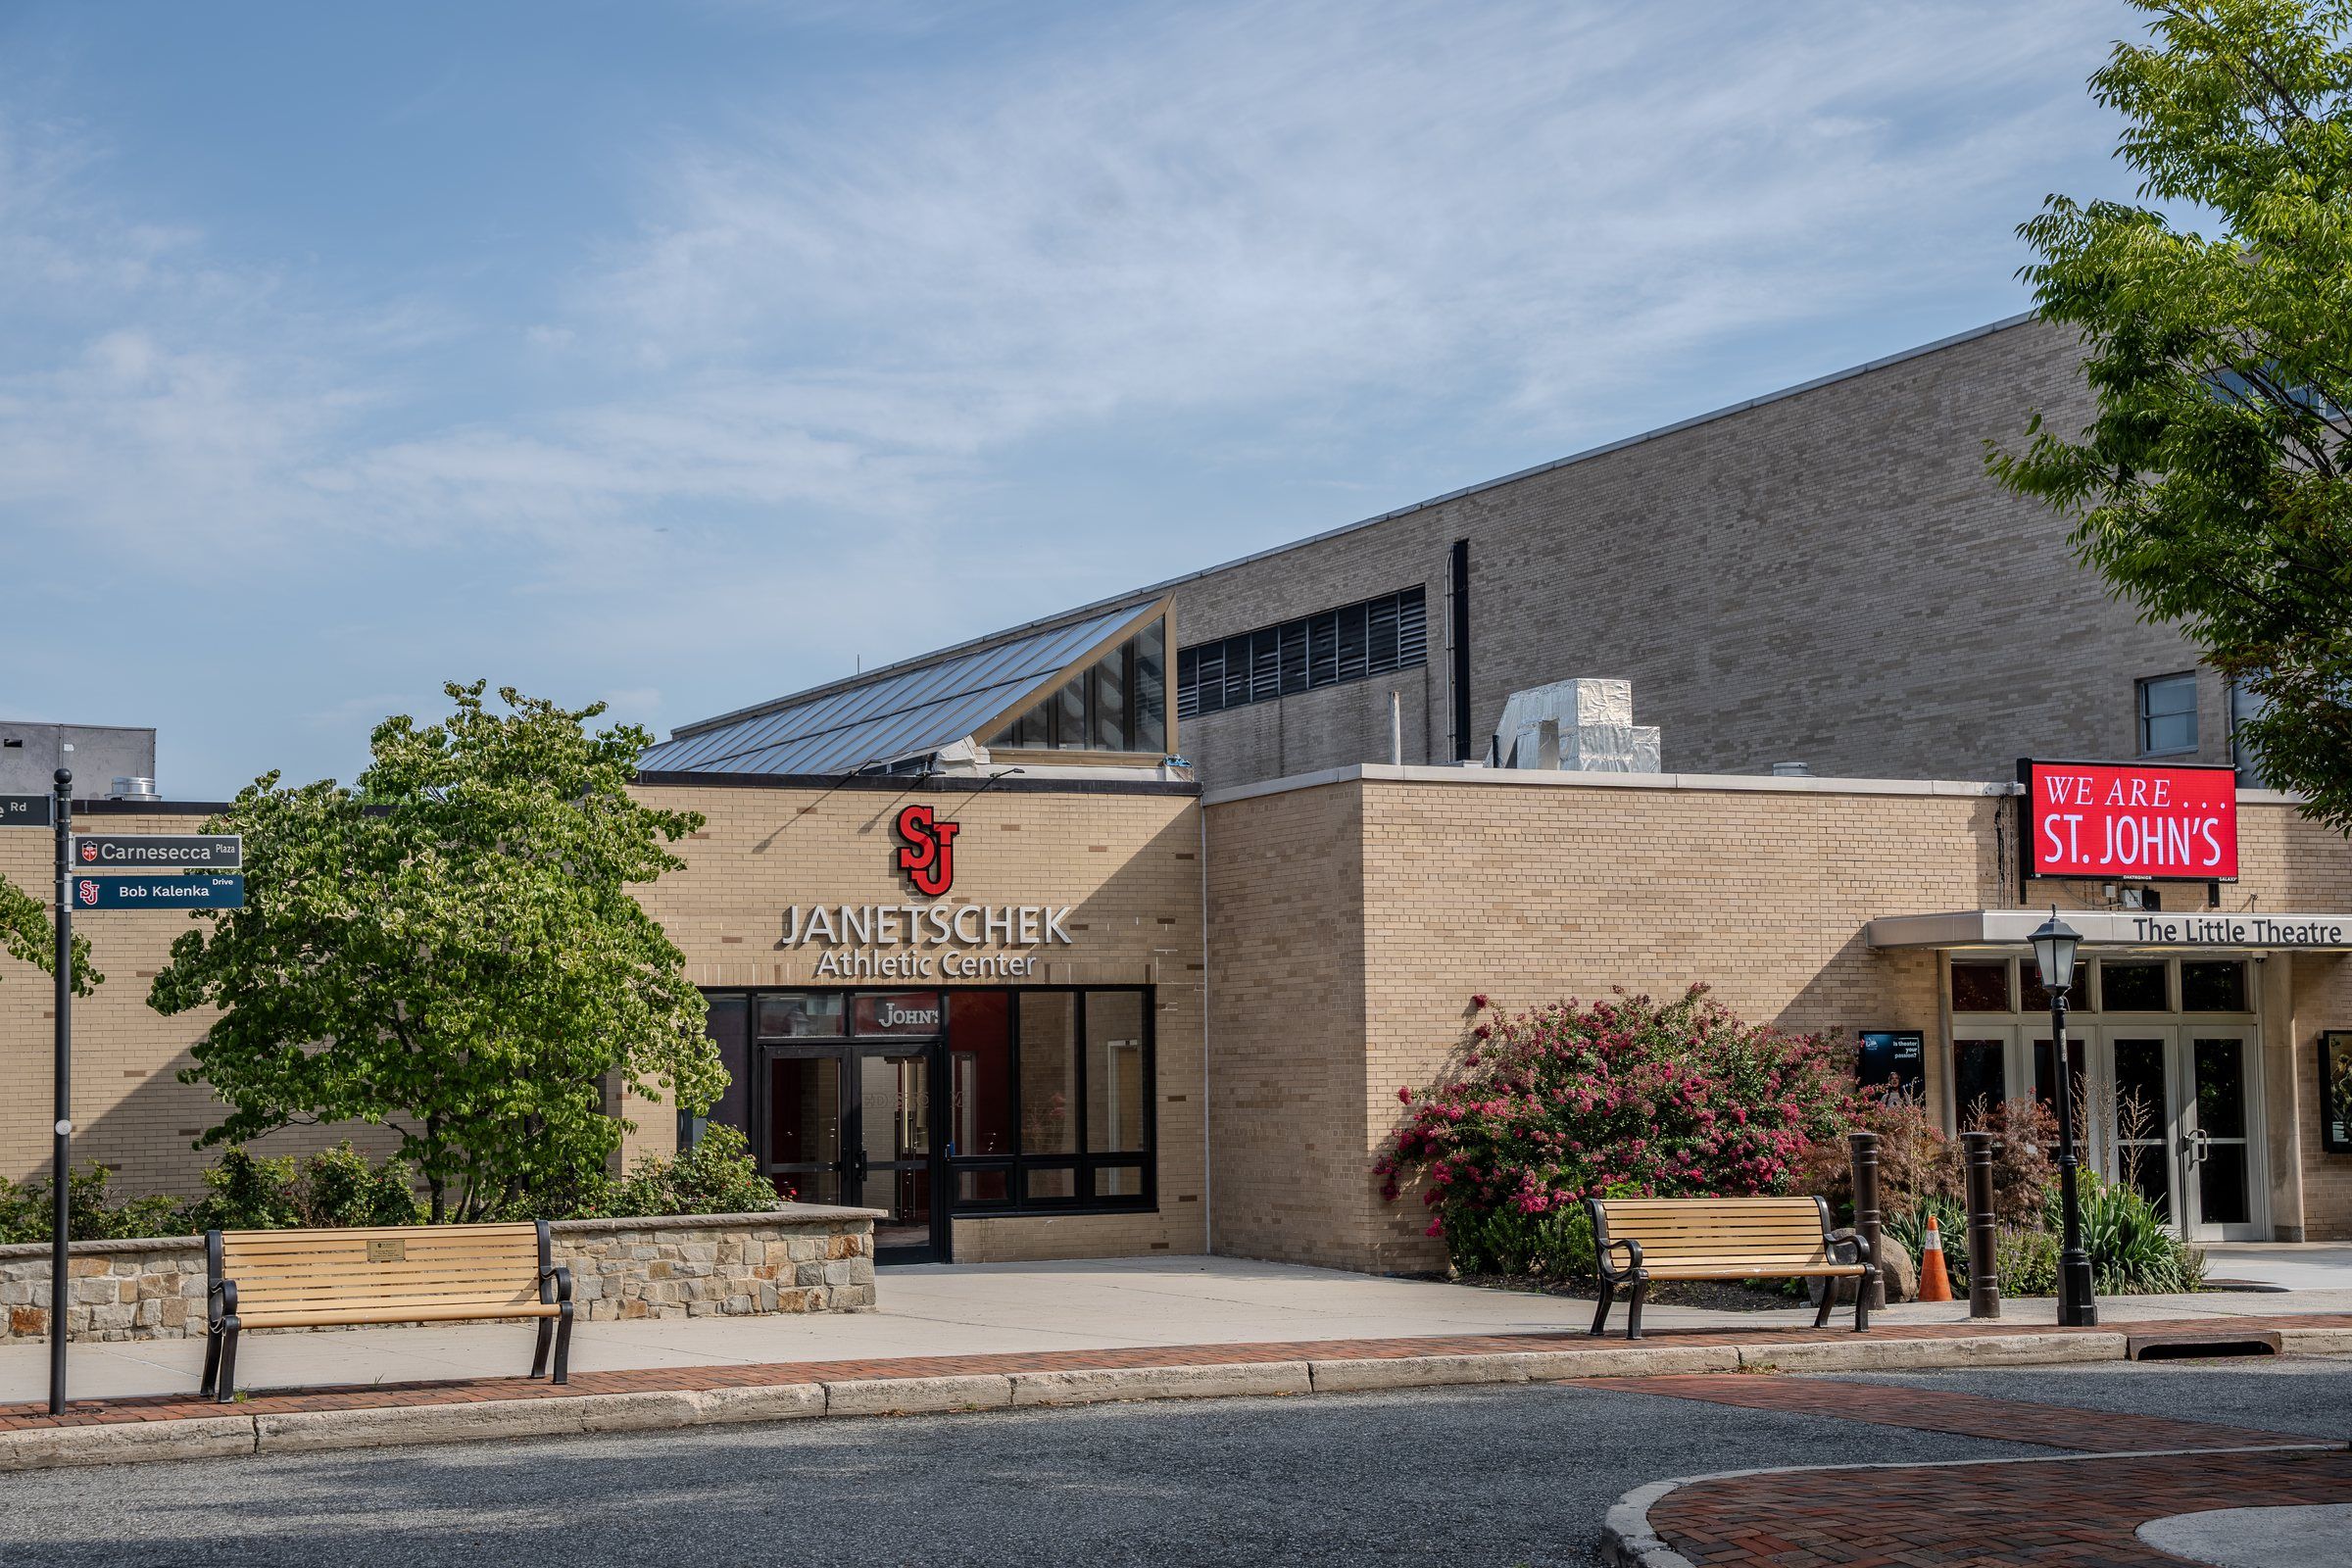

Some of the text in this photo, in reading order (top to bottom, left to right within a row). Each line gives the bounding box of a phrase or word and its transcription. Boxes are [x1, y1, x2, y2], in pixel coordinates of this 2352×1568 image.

[2044, 775, 2094, 805] WE
[2104, 778, 2171, 808] ARE
[10, 802, 26, 811] Rd
[101, 843, 235, 859] Carnesecca Plaza
[2044, 813, 2222, 866] ST. JOHN'S
[120, 885, 147, 897] Bob
[152, 885, 210, 897] Kalenka
[782, 905, 1072, 944] JANETSCHEK
[2132, 917, 2341, 944] The Little Theatre
[816, 949, 1037, 976] Athletic Center
